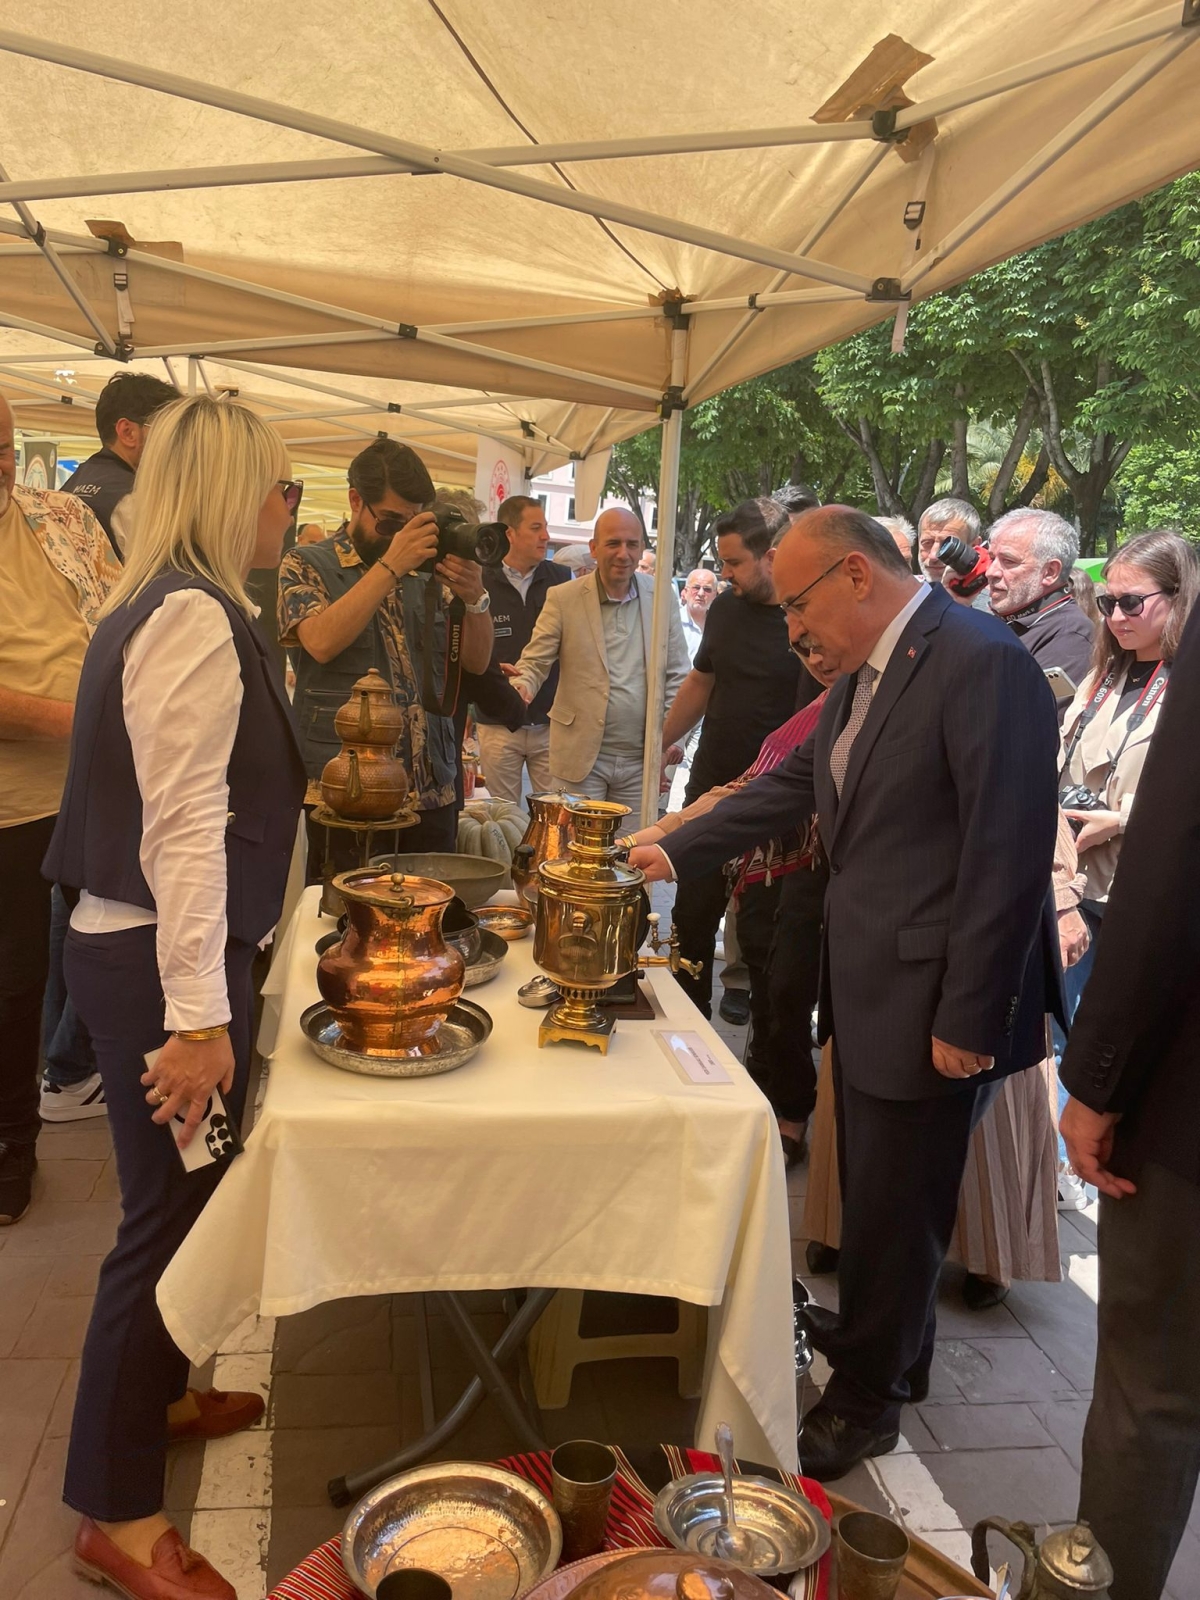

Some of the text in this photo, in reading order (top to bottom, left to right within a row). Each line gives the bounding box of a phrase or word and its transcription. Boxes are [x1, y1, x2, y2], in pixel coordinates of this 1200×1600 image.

[450, 624, 460, 662] Canon
[1094, 687, 1108, 703] 60D
[1142, 677, 1165, 706] Canon
